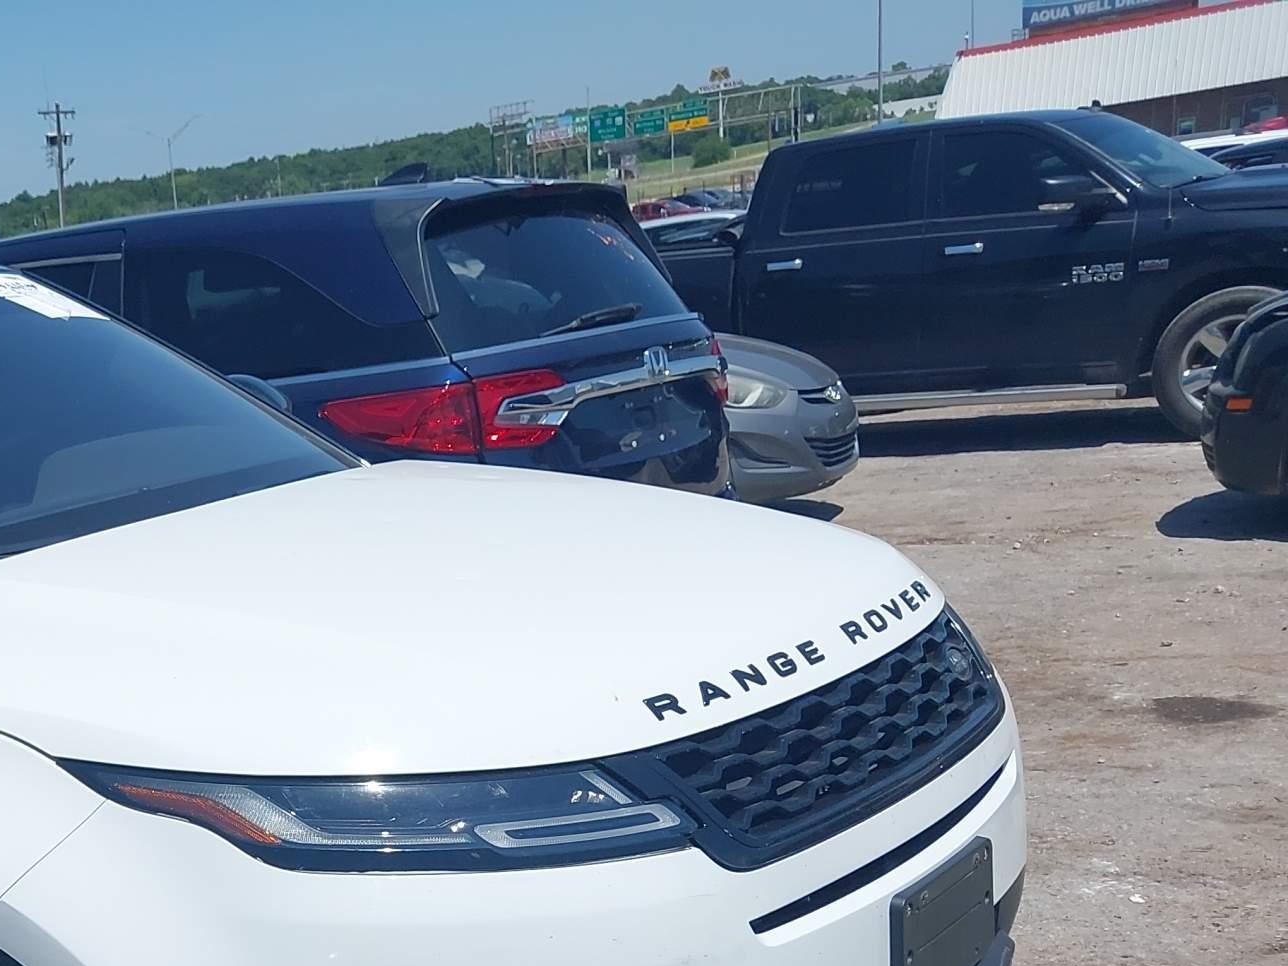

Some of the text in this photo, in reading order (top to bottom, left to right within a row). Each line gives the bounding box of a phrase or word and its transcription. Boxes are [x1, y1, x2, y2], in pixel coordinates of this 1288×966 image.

[1030, 6, 1071, 24] AQUA
[1072, 0, 1111, 16] WELL
[642, 580, 931, 721] RANGE ROVER
